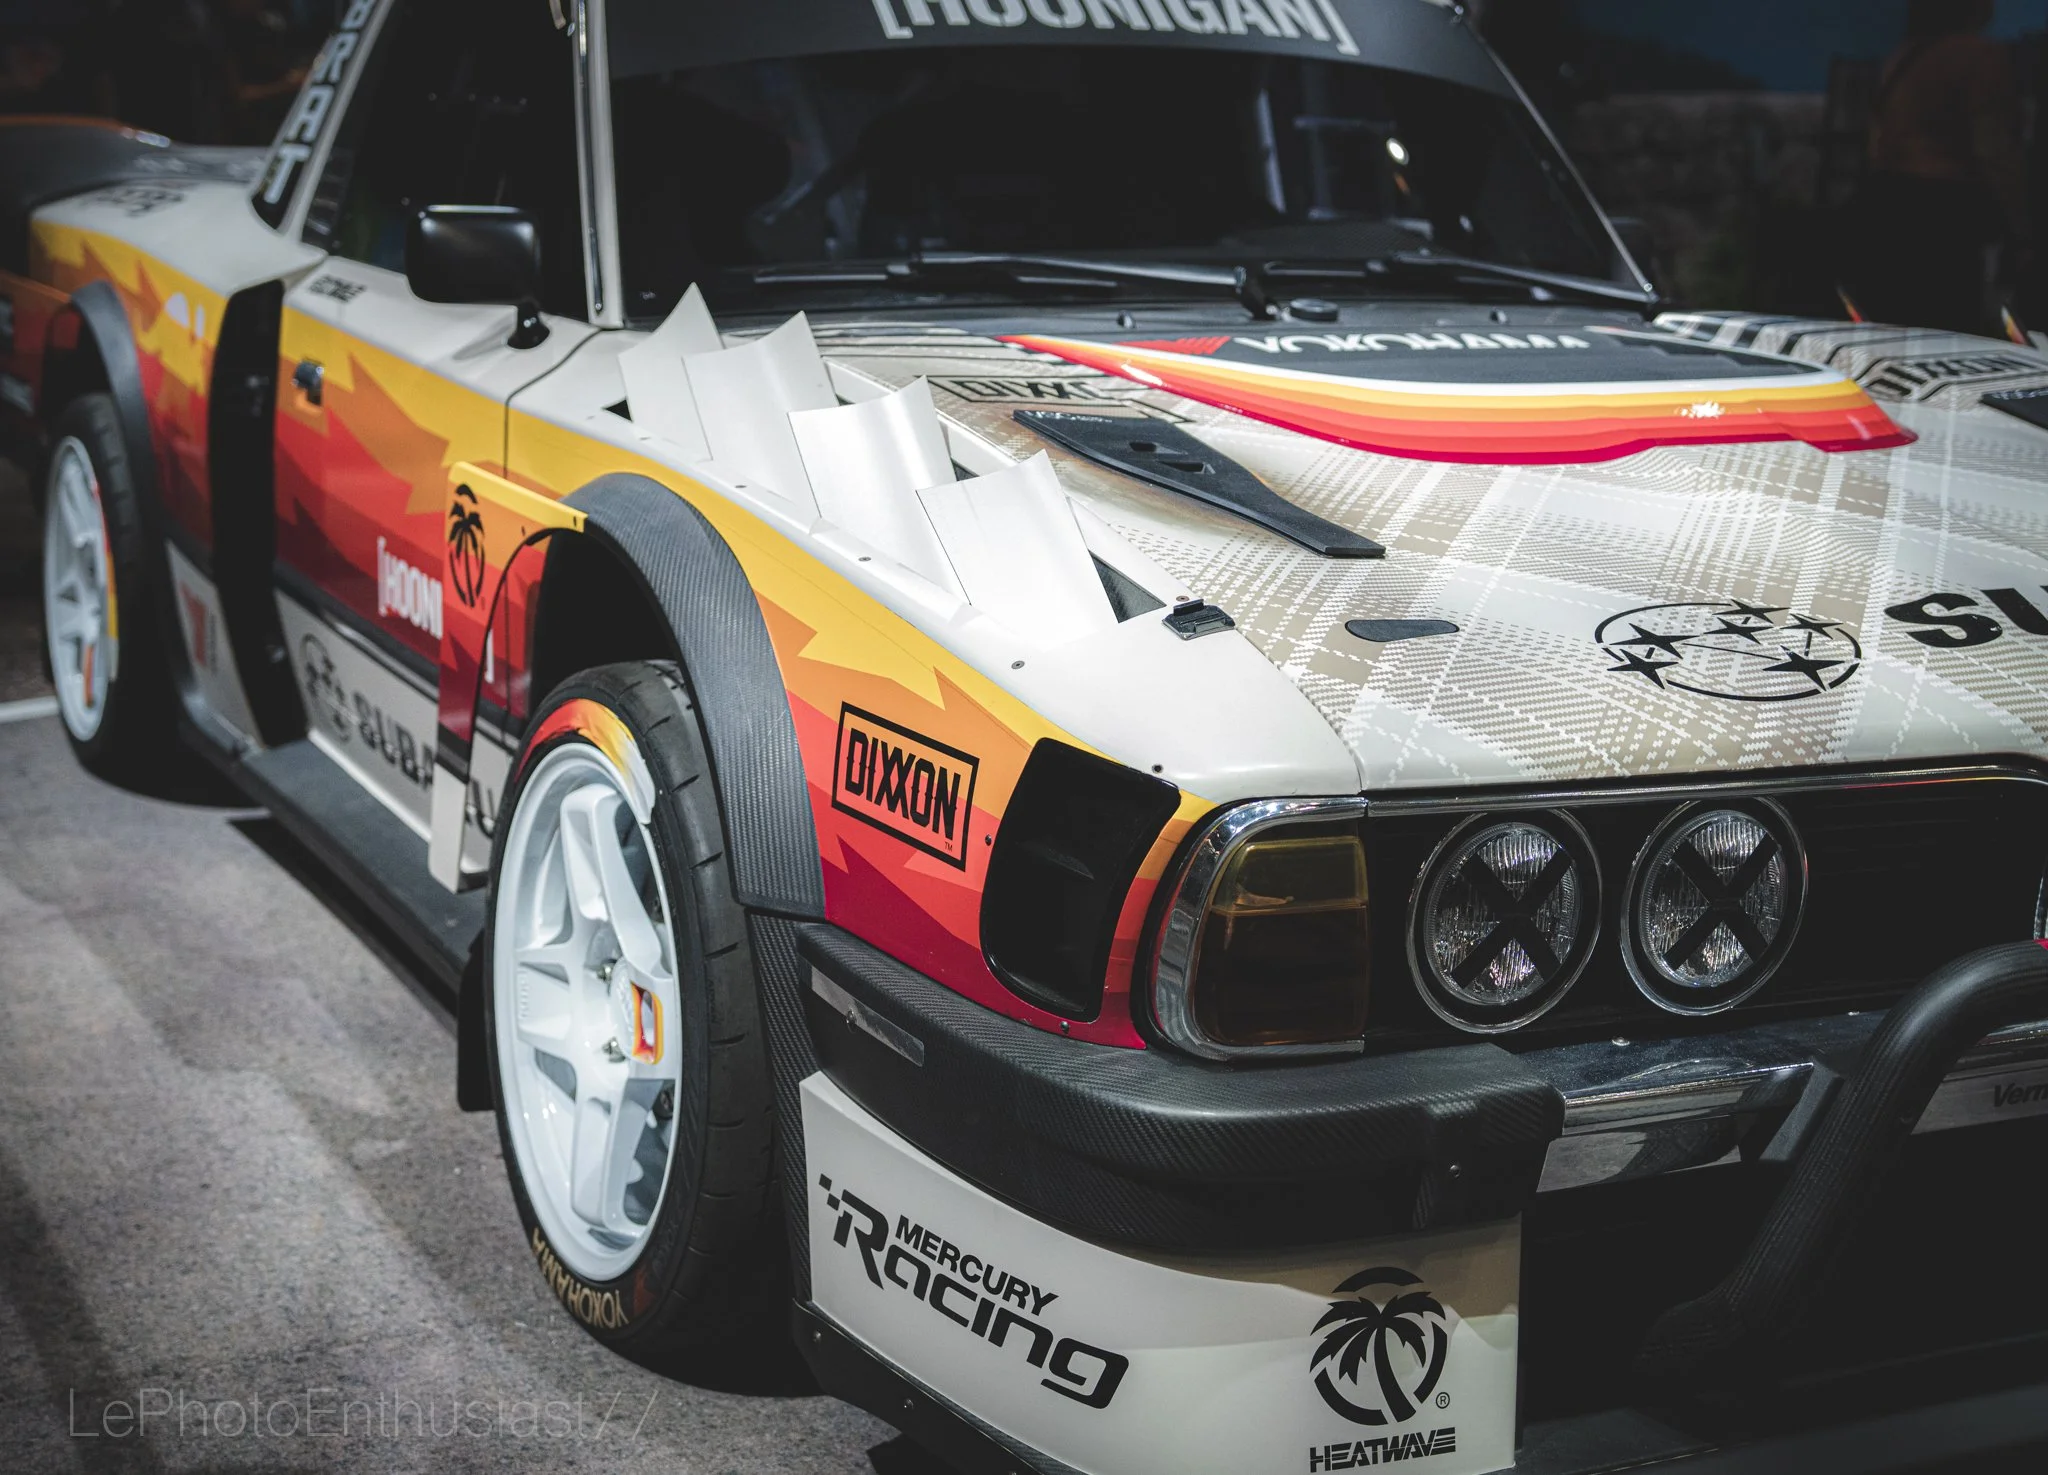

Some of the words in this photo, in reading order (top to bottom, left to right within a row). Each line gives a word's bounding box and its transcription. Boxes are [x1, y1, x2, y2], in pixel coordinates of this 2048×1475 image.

[845, 727, 961, 841] DIXXON
[532, 1227, 629, 1329] YOKOHAMA
[895, 1214, 1059, 1316] MERCURY
[1309, 1426, 1457, 1473] HEATWAVE
